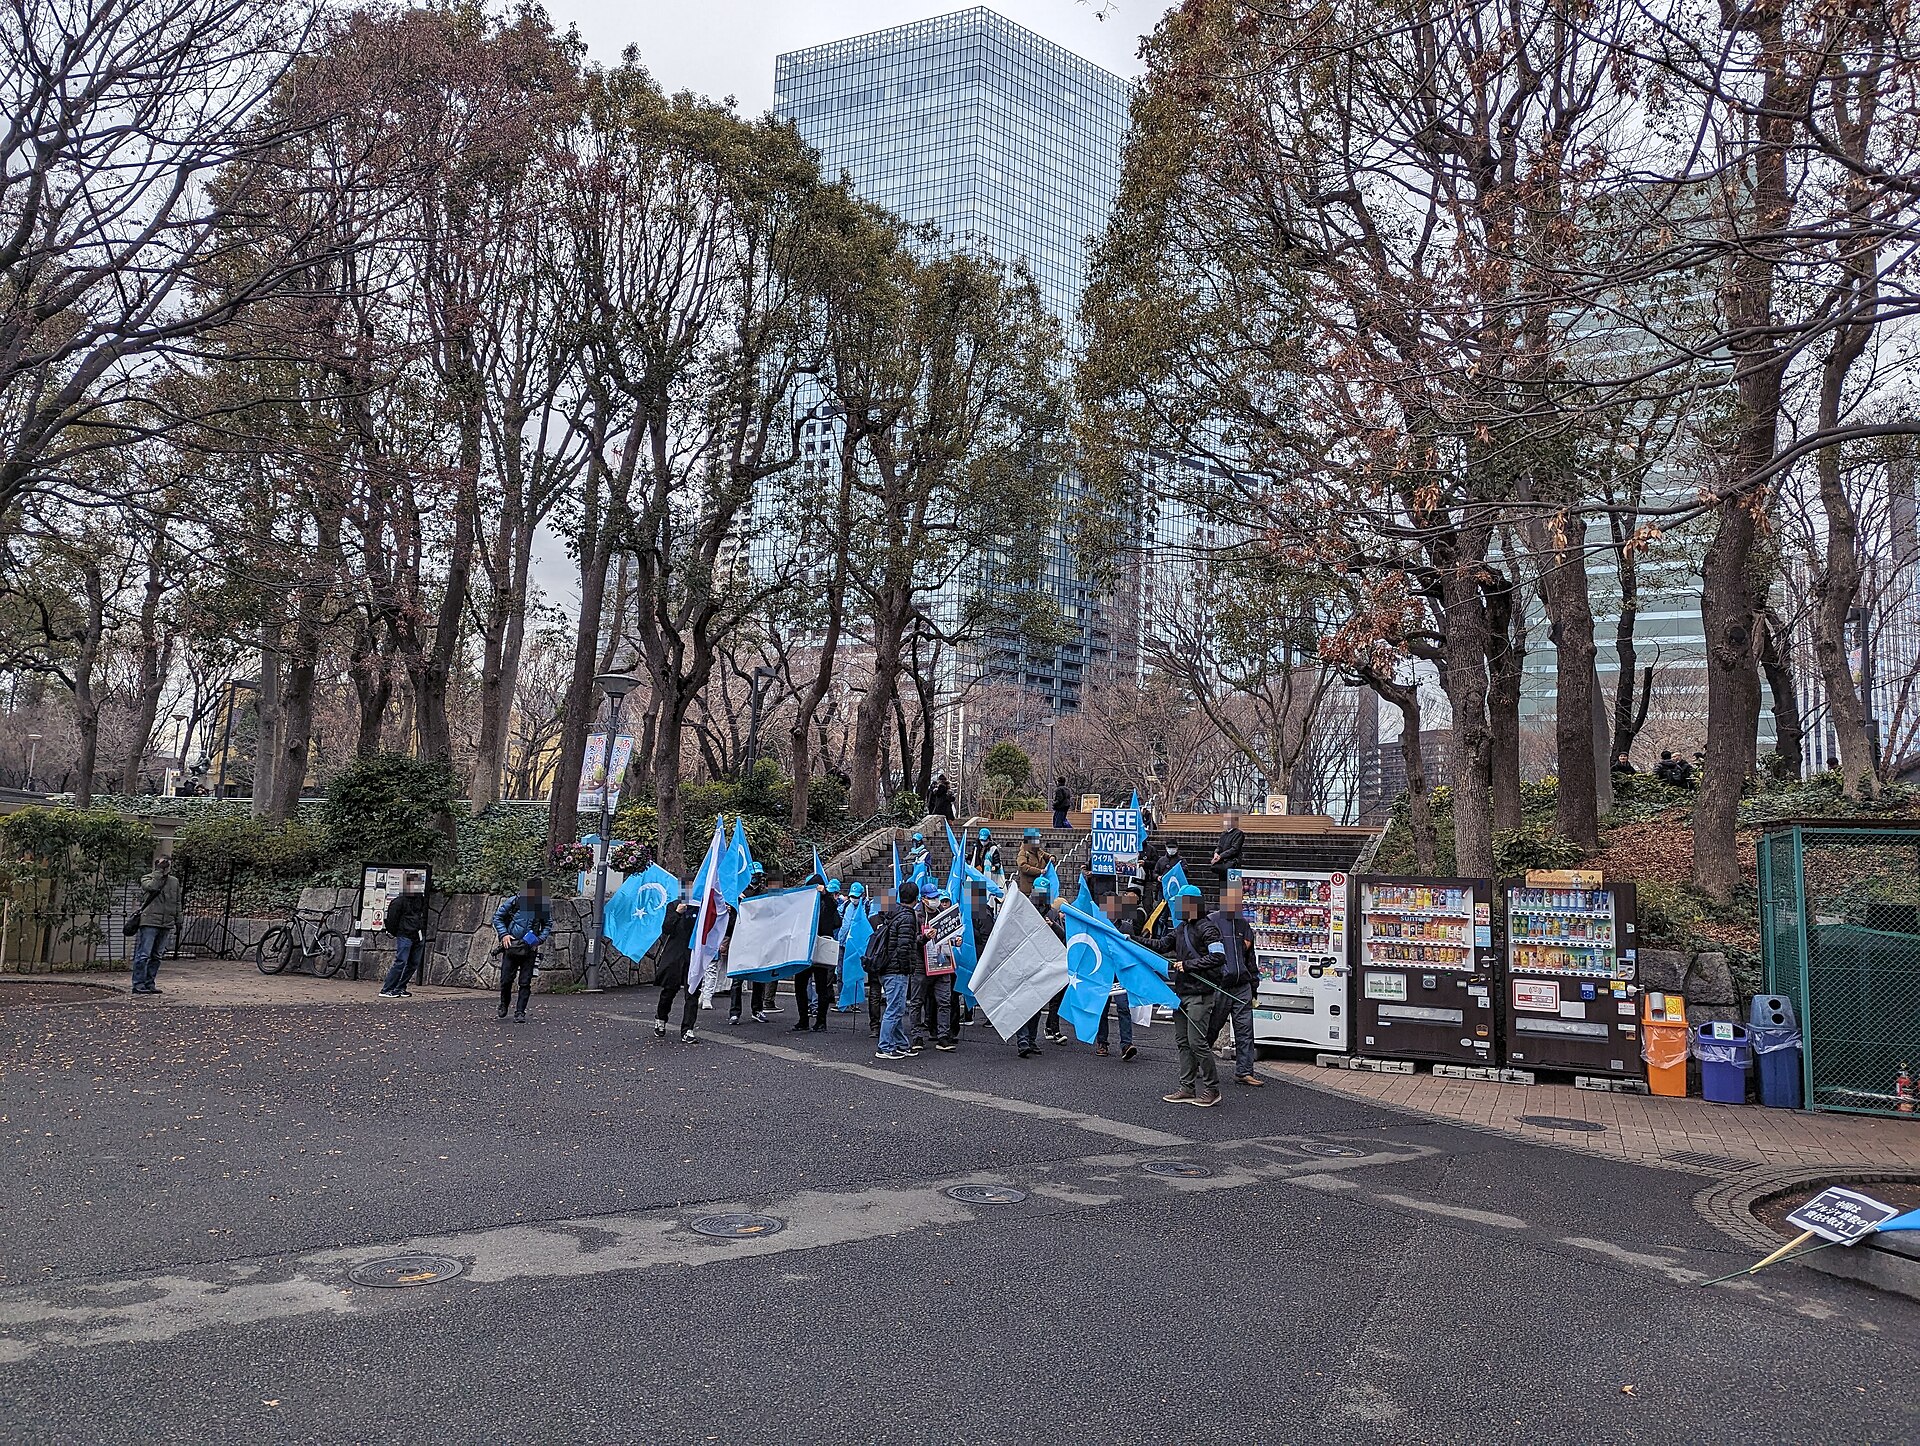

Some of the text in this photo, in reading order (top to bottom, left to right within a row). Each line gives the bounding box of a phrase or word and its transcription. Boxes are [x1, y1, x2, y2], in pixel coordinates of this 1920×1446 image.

[1093, 811, 1136, 829] FREE
[1093, 833, 1136, 852] UYGHUR
[1093, 854, 1113, 862] ウイグル
